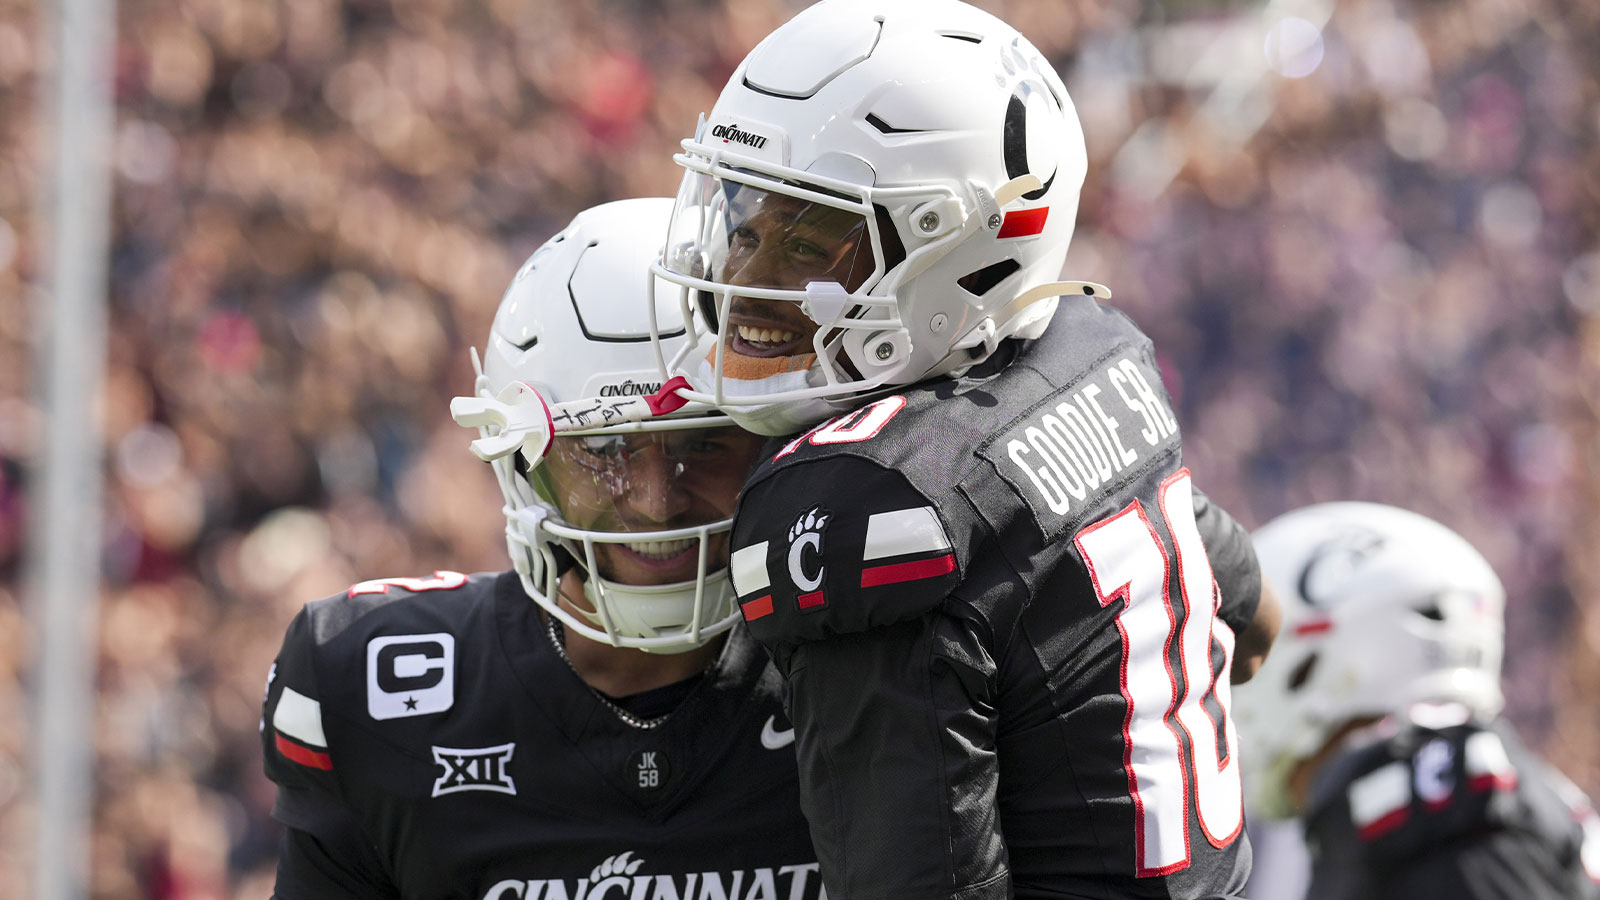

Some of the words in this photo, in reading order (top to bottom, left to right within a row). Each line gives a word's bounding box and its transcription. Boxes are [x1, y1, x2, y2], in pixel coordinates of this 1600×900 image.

[712, 124, 767, 149] CINCINNATI
[600, 379, 662, 398] CINCINNA
[1006, 383, 1138, 516] GOODIE
[788, 530, 825, 593] C
[376, 640, 445, 694] C
[1073, 467, 1244, 878] 10
[437, 753, 514, 792] XII
[637, 751, 658, 770] JK
[638, 769, 659, 788] 58
